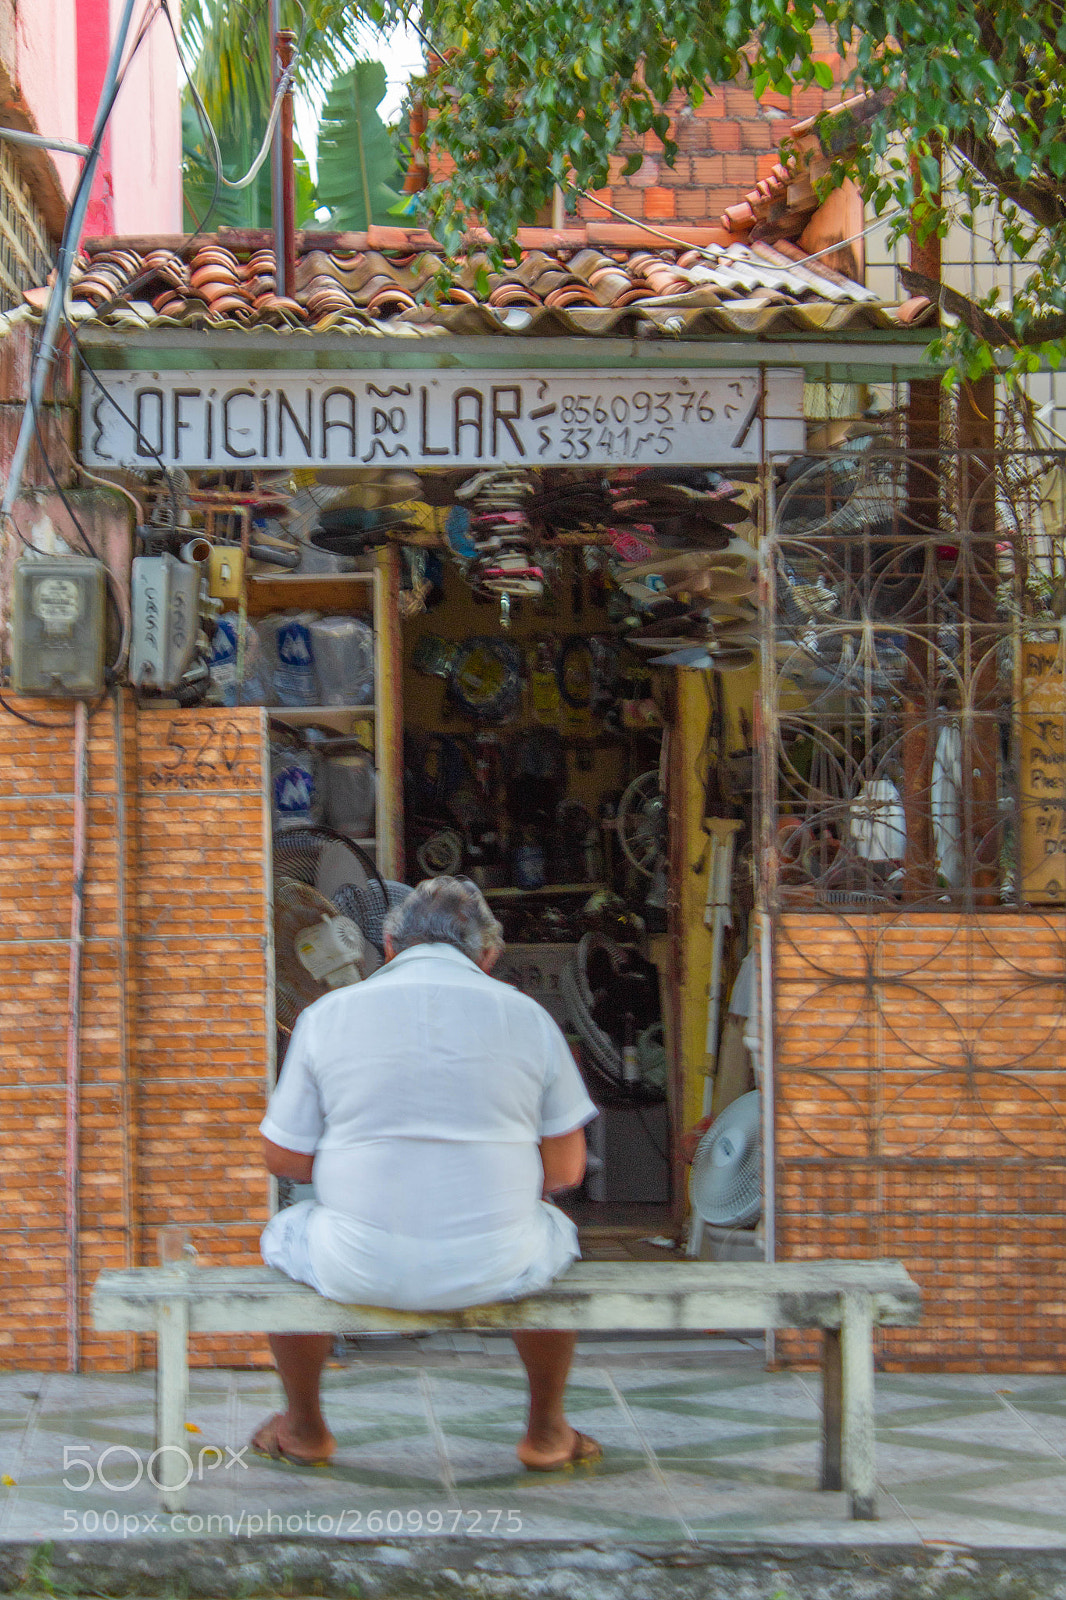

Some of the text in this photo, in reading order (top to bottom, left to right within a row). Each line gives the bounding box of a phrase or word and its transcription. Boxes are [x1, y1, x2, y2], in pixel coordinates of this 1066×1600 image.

[373, 406, 405, 434] DO
[420, 384, 527, 457] LAR
[561, 391, 714, 424] 85609376
[144, 587, 158, 651] CASA
[163, 721, 241, 770] 520
